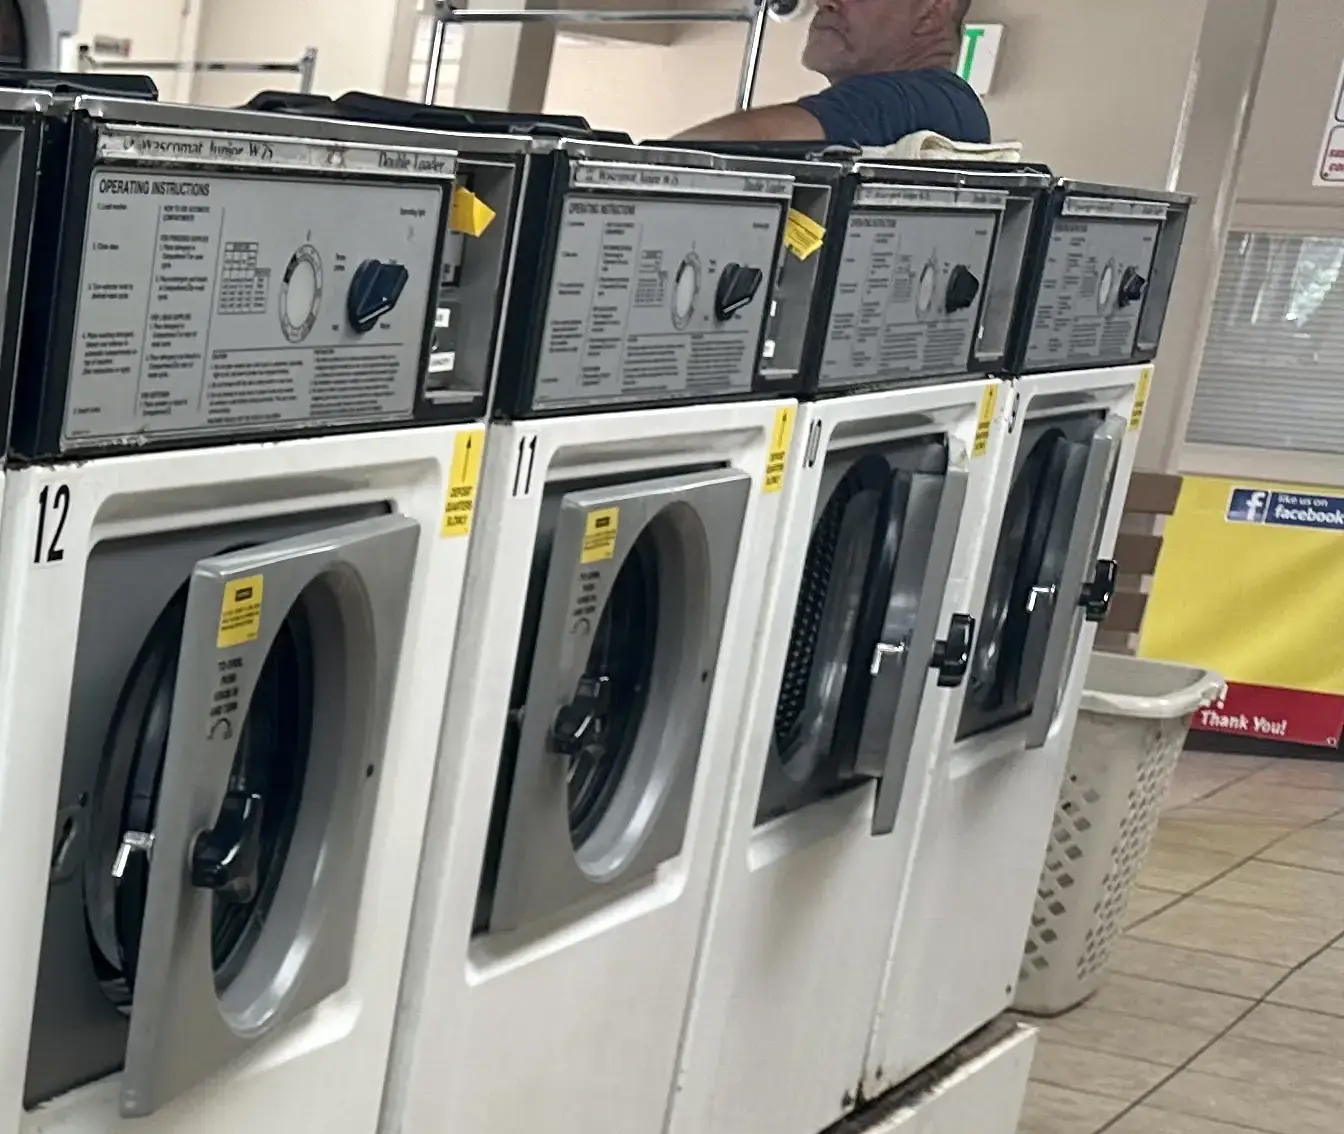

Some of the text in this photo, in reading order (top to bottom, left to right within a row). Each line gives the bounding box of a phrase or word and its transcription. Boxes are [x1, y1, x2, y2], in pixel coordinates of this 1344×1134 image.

[99, 179, 210, 196] OPERATING INSTRUCTIONS
[513, 435, 537, 496] 11
[1278, 494, 1328, 507] like us on
[34, 485, 69, 563] 12
[1274, 505, 1344, 524] facebook
[1200, 710, 1288, 736] Thank You!
